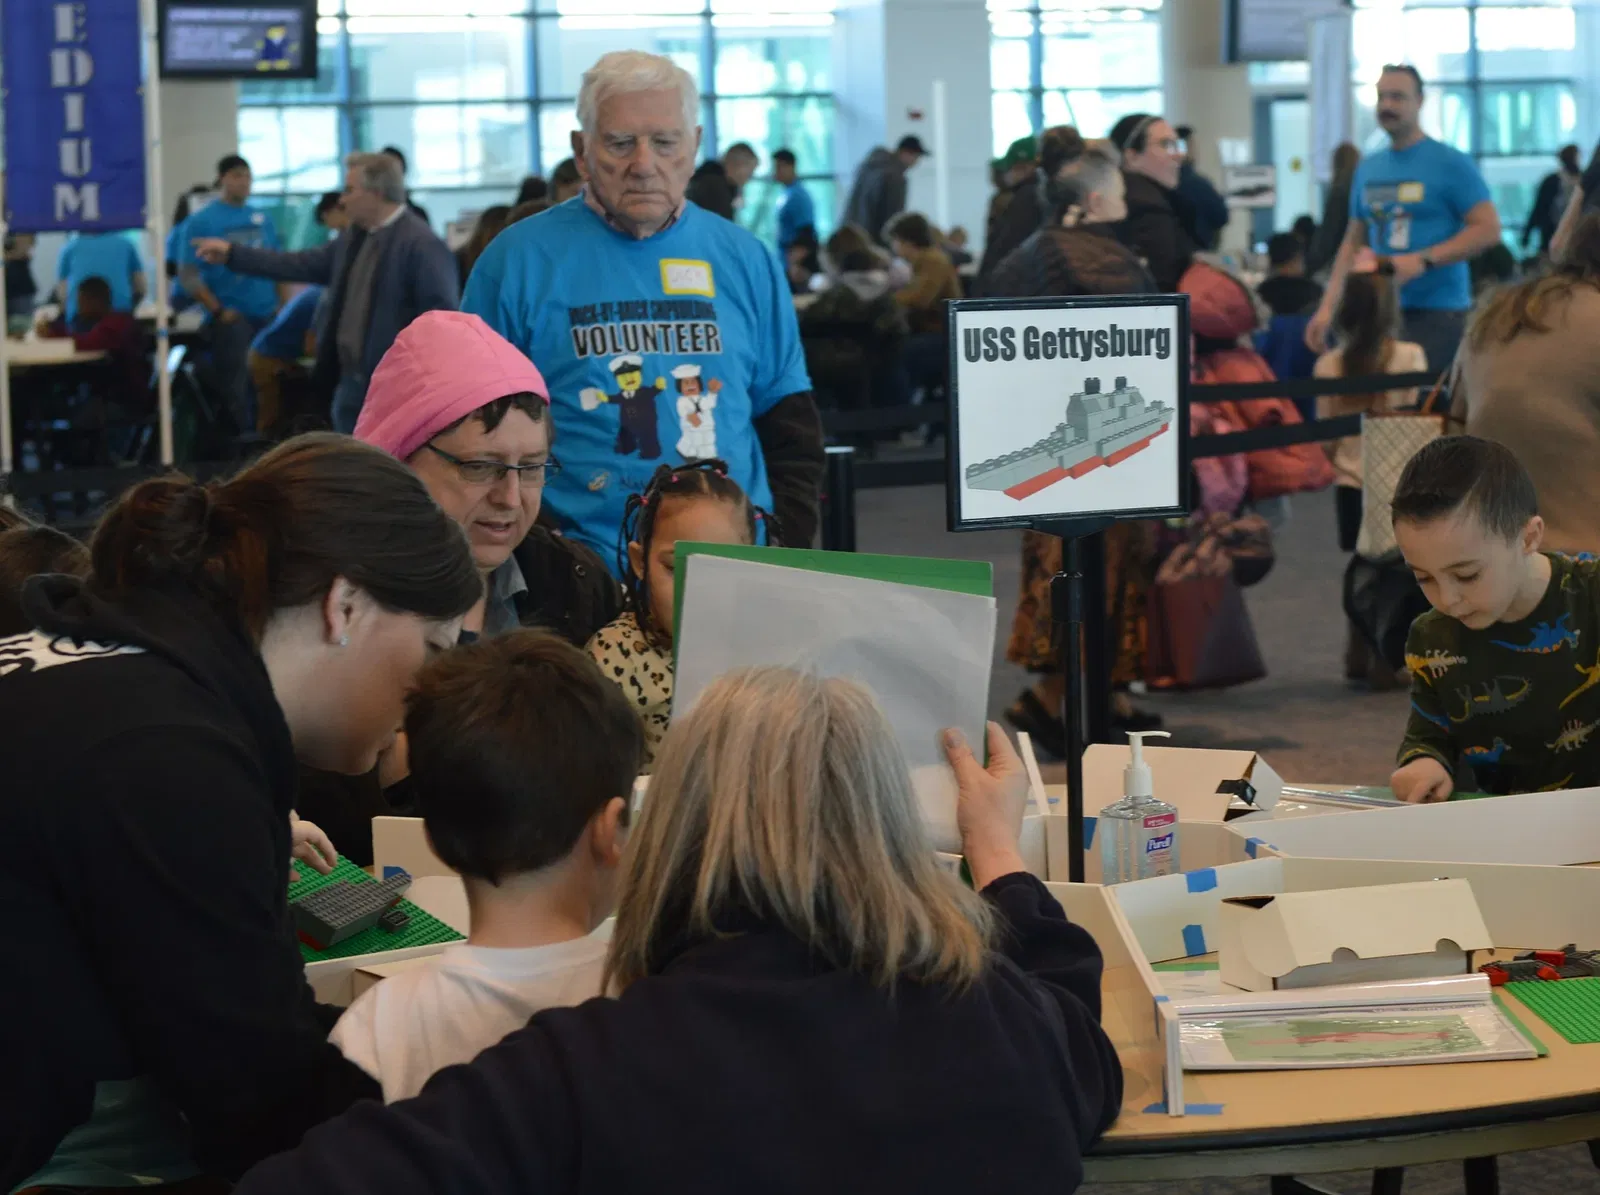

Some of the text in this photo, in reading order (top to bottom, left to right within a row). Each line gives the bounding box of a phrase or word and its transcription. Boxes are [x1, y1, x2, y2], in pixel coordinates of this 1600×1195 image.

[51, 3, 100, 221] EDIUM
[571, 322, 721, 358] VOLUNTEER
[964, 324, 1170, 362] USS Gettysburg
